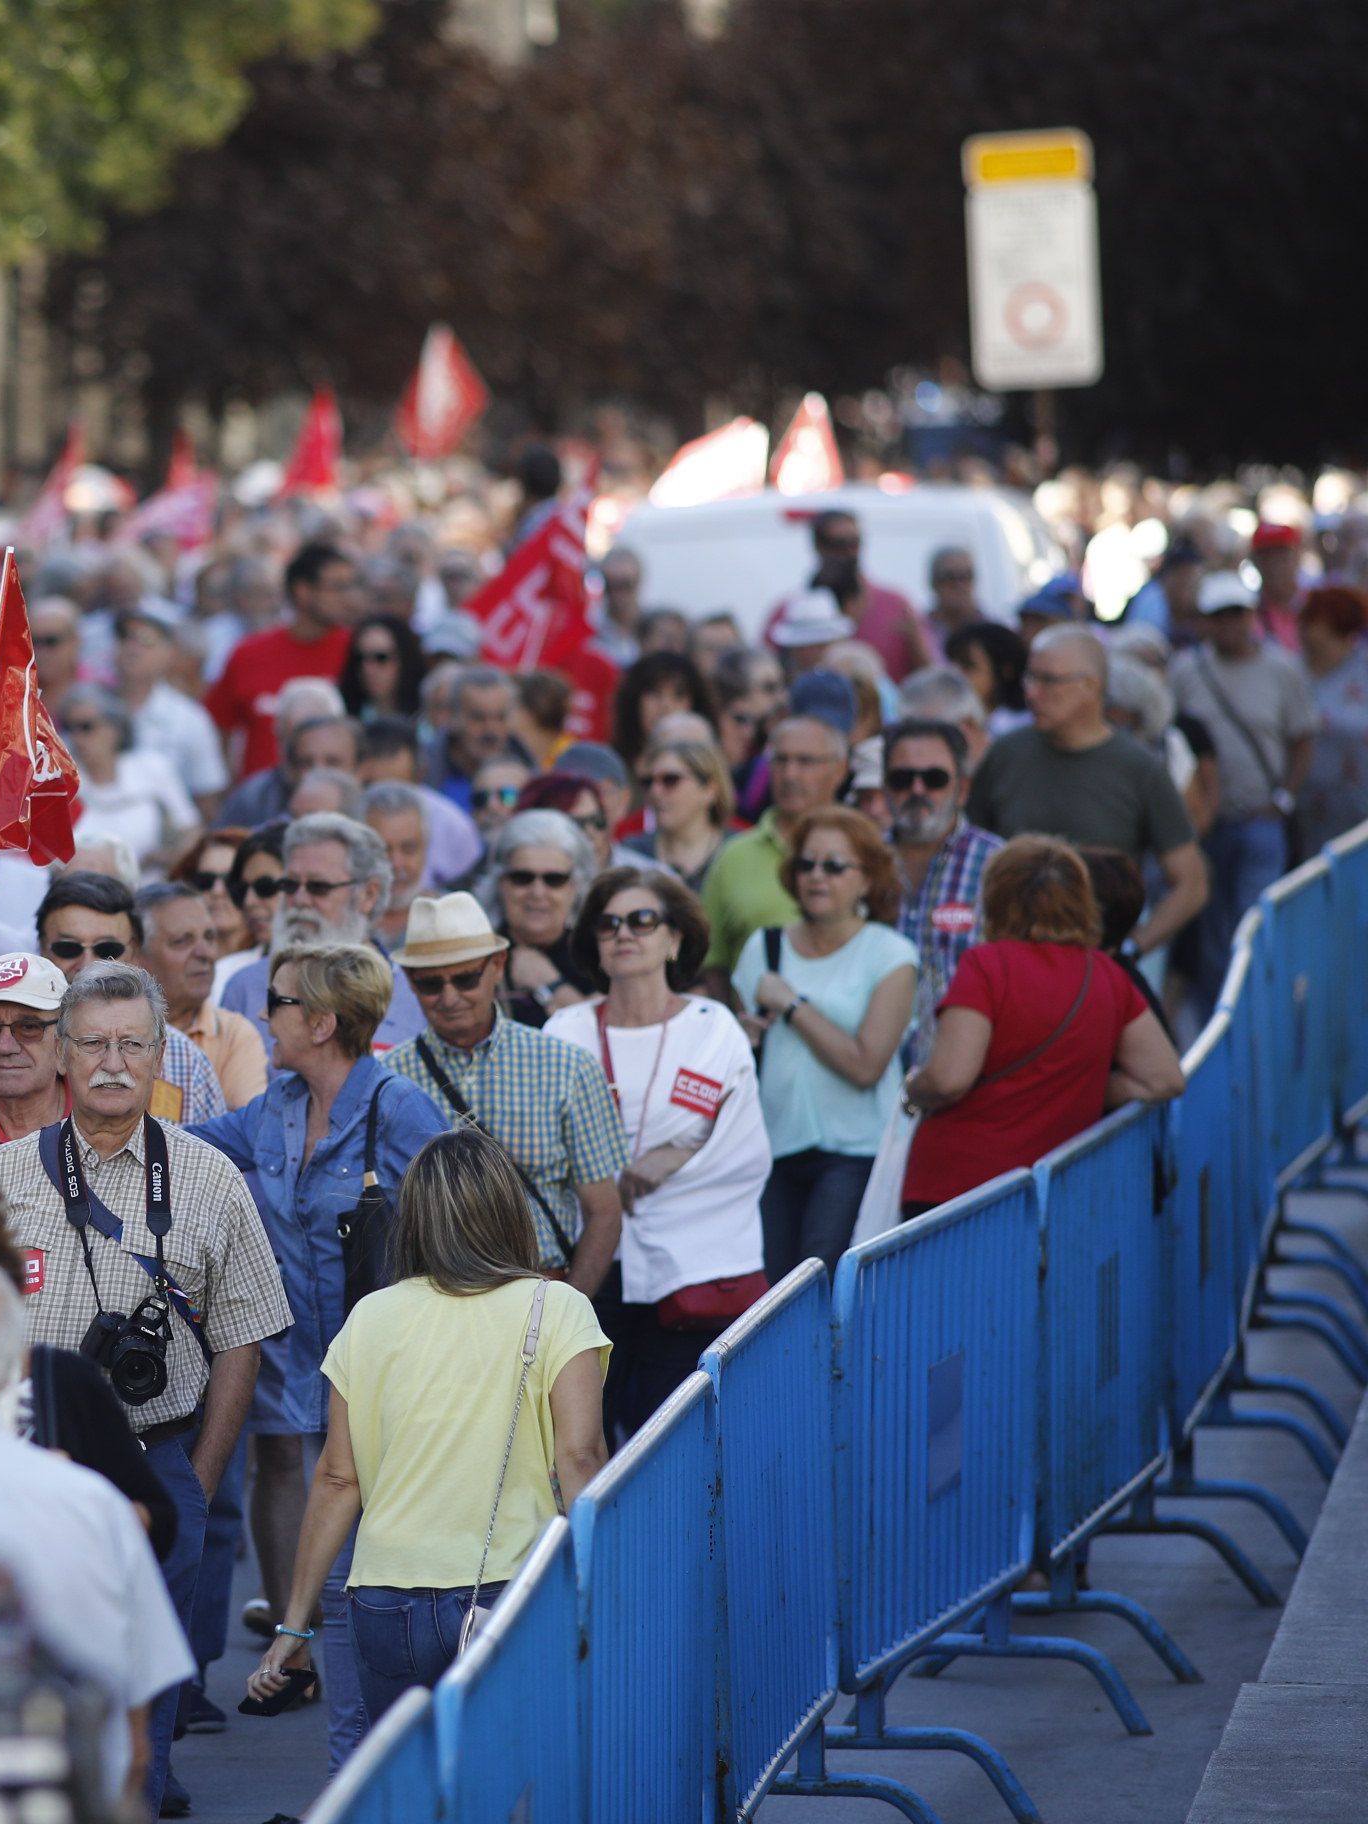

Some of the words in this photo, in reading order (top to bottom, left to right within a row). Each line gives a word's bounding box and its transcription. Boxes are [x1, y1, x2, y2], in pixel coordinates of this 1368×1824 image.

[64, 1133, 75, 1174] DIGITAL
[68, 1175, 80, 1198] EOS
[151, 1162, 163, 1202] Canon
